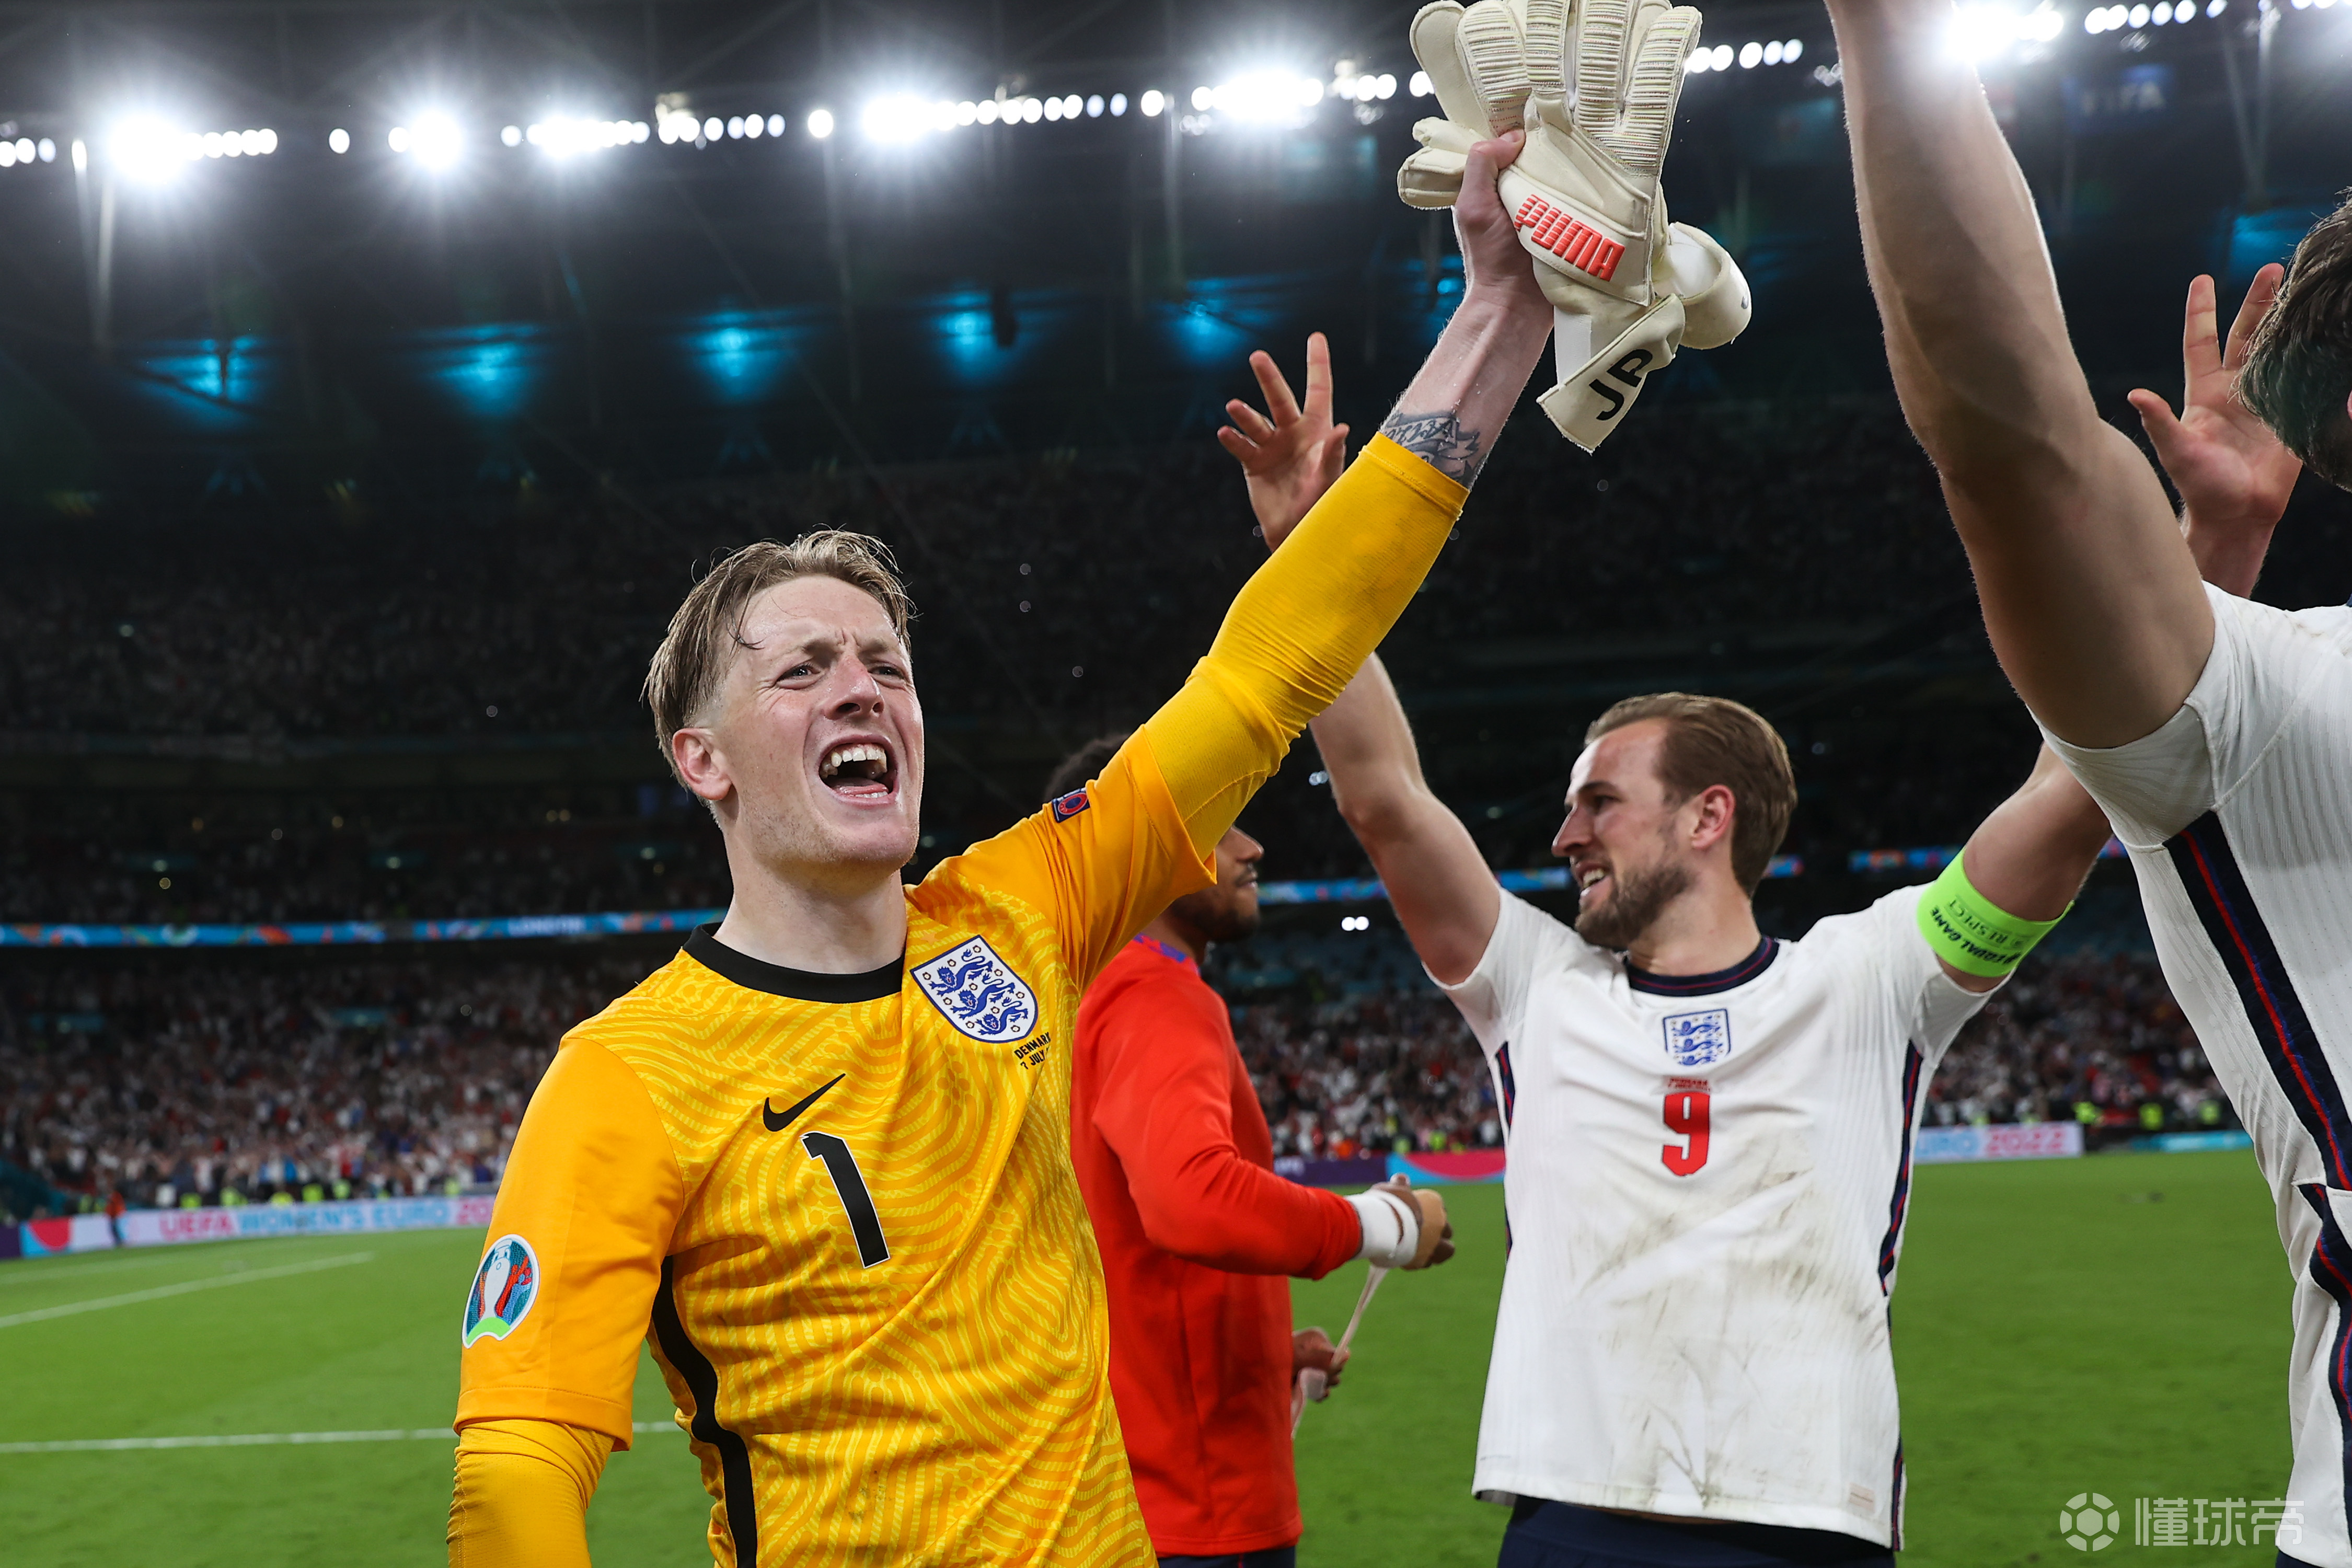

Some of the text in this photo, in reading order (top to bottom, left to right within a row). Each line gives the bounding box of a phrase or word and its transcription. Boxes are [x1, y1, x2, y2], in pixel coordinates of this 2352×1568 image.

[1514, 193, 1626, 282] PUMA
[1589, 348, 1653, 421] JP
[1949, 899, 2009, 944] RESPECT
[1013, 1031, 1052, 1059] DENMARK
[1020, 1050, 1045, 1070] 7 JULY
[1661, 1091, 1711, 1177] 9
[1915, 1125, 2067, 1157] URO 2022
[159, 1197, 492, 1239] UEFA WOMEN'S EURO 20
[799, 1131, 891, 1269] 1
